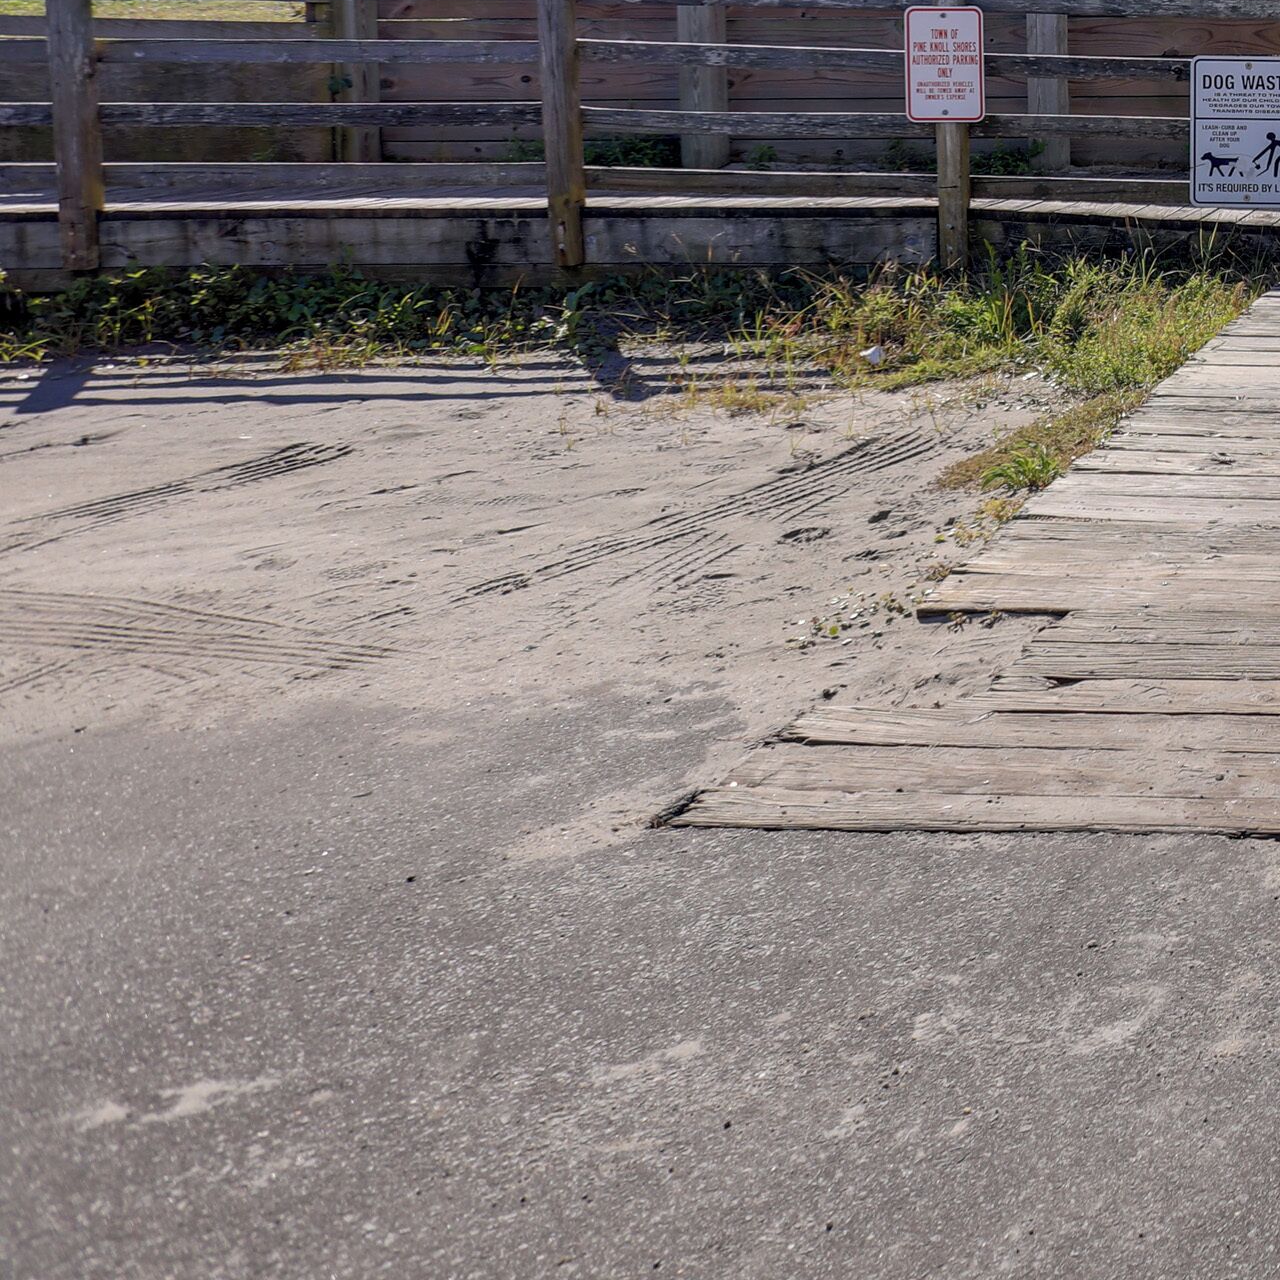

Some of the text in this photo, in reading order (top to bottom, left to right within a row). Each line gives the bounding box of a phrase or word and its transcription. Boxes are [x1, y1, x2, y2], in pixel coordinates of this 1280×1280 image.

[931, 29, 959, 39] TOWN OF
[913, 42, 976, 52] PINE KNOLL SHORES
[912, 55, 978, 65] AUTHORIZED PARKING
[937, 68, 953, 78] ONLY
[1202, 75, 1235, 90] DOG
[1198, 183, 1214, 192] IT'S
[1216, 184, 1259, 193] REQUIRED
[1262, 184, 1273, 193] BY
